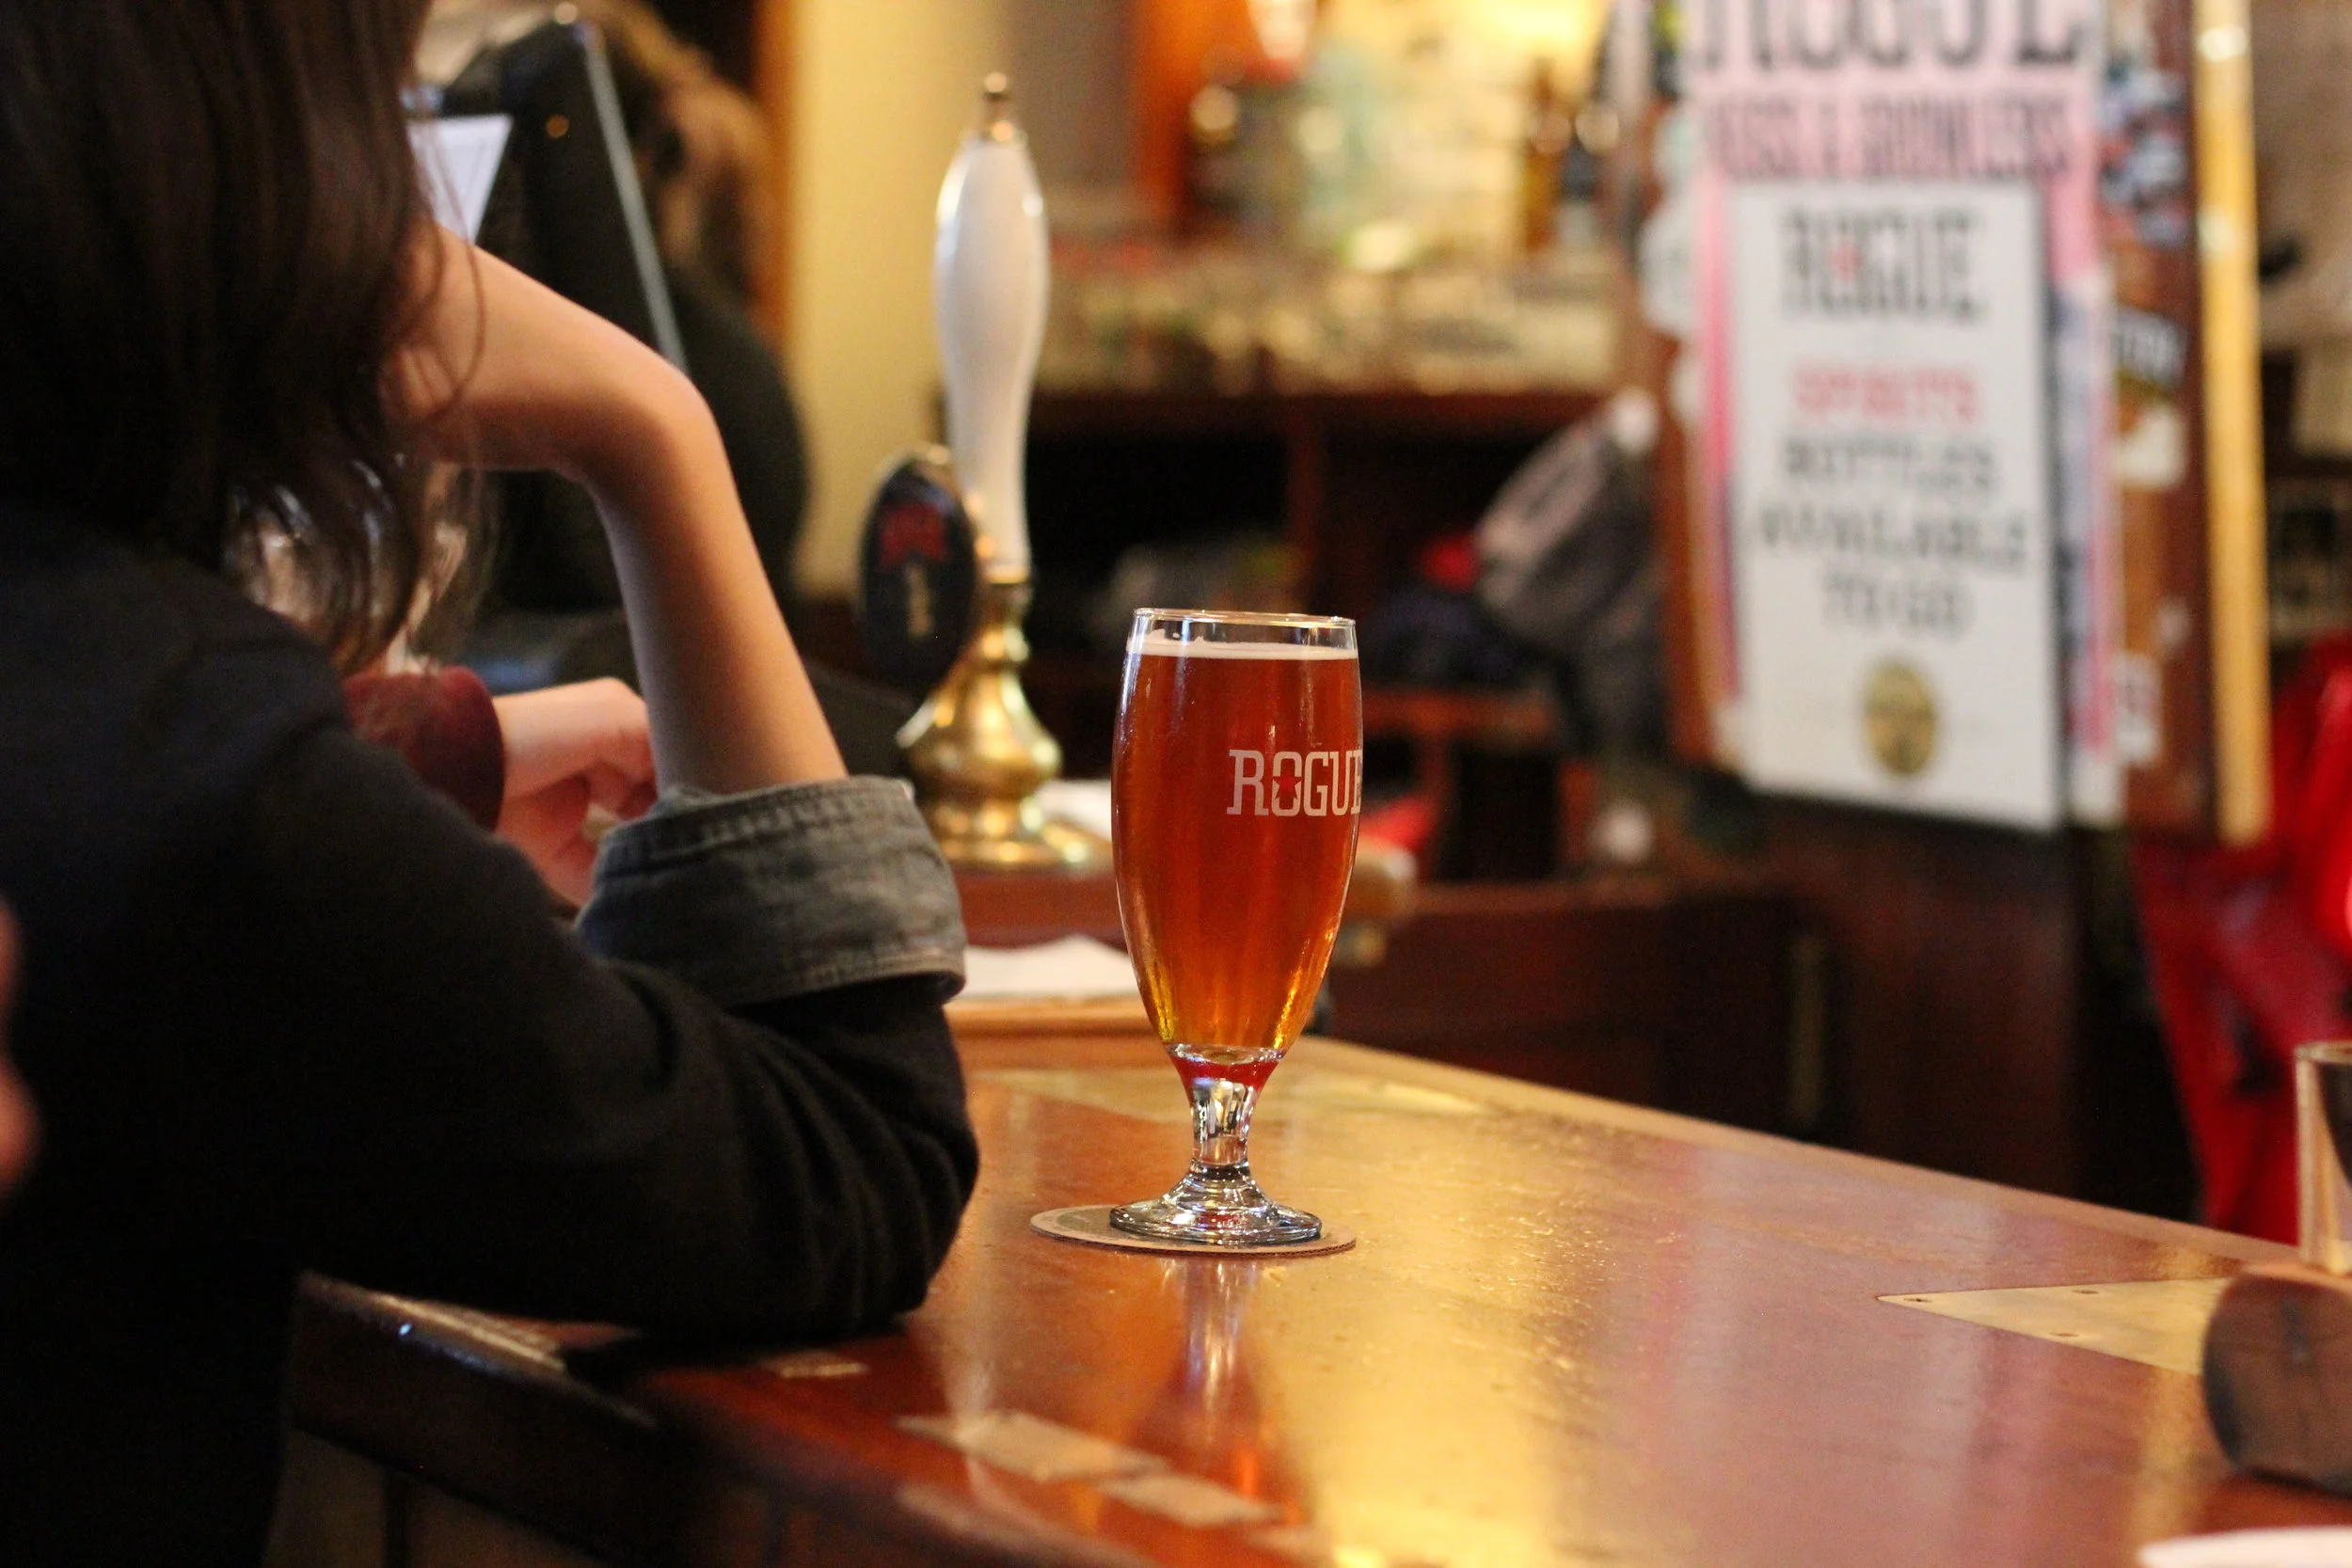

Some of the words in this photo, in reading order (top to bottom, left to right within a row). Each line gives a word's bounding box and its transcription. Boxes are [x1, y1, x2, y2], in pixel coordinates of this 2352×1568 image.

[1781, 207, 1983, 323] ROGUE
[1792, 368, 1981, 425] SPIRITS
[1781, 435, 1996, 499] BOTTLES
[1759, 502, 2030, 574] AVAILABLE
[1822, 570, 1891, 625] TO
[1899, 578, 1969, 638] GO
